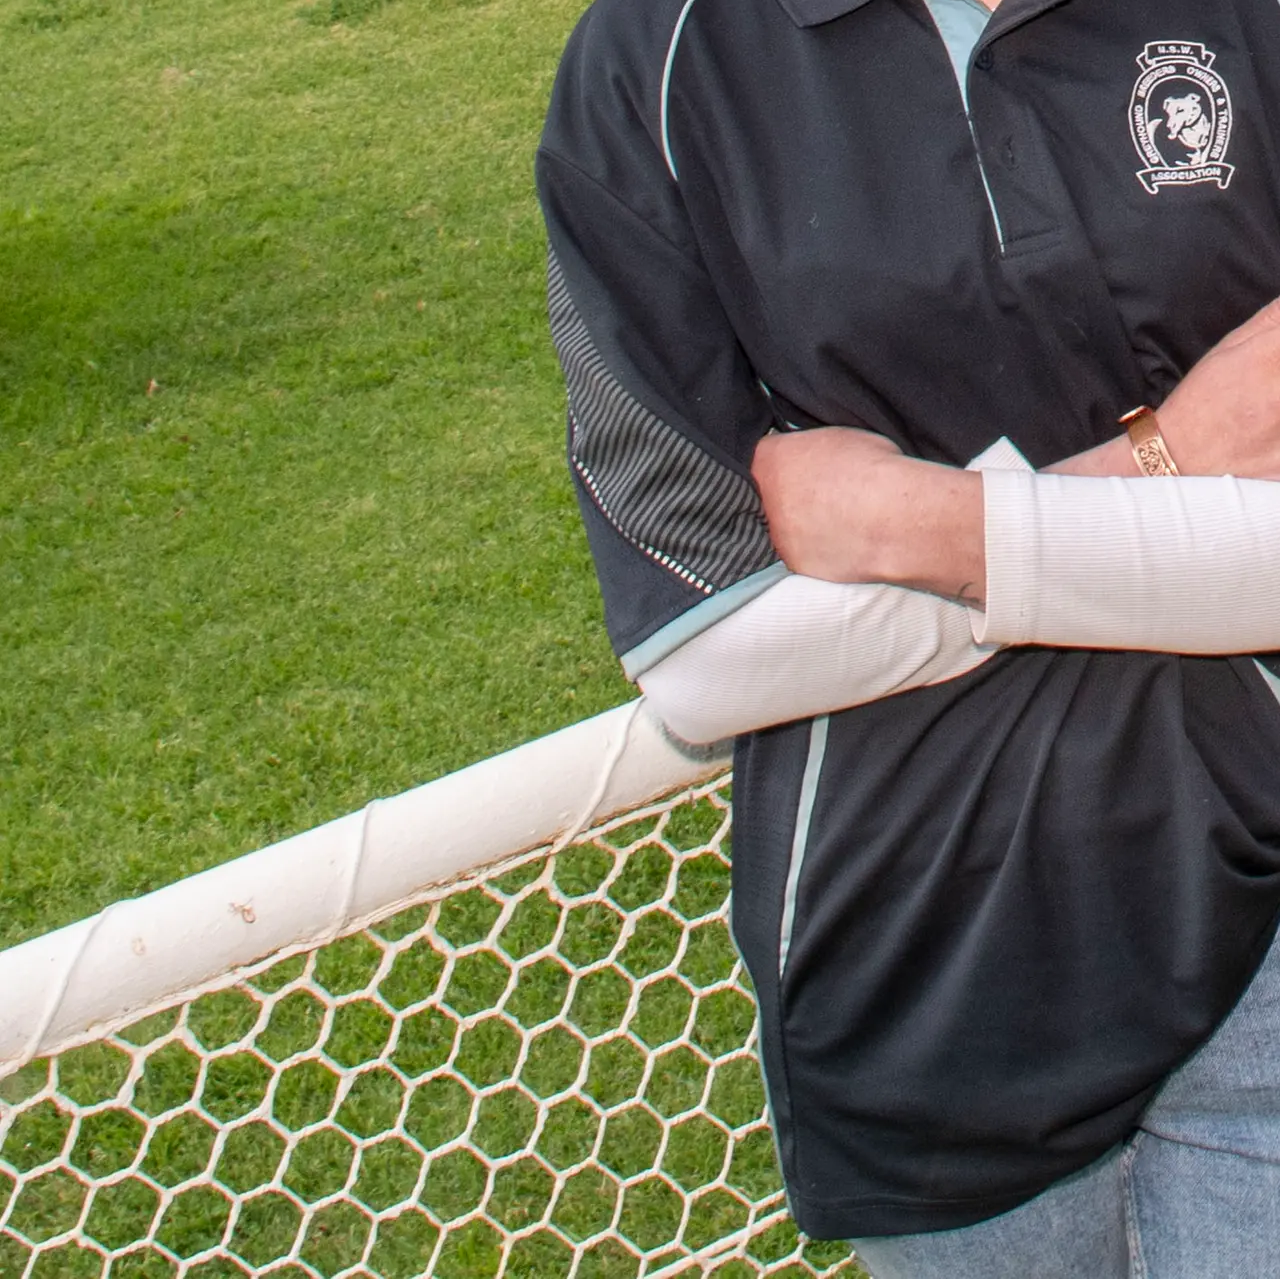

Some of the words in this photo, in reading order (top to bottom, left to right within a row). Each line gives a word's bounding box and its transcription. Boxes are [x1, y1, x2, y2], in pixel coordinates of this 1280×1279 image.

[1186, 66, 1222, 93] OWNERS
[1209, 108, 1229, 160] TRAINERS
[1150, 167, 1222, 182] ASSOCIATION
